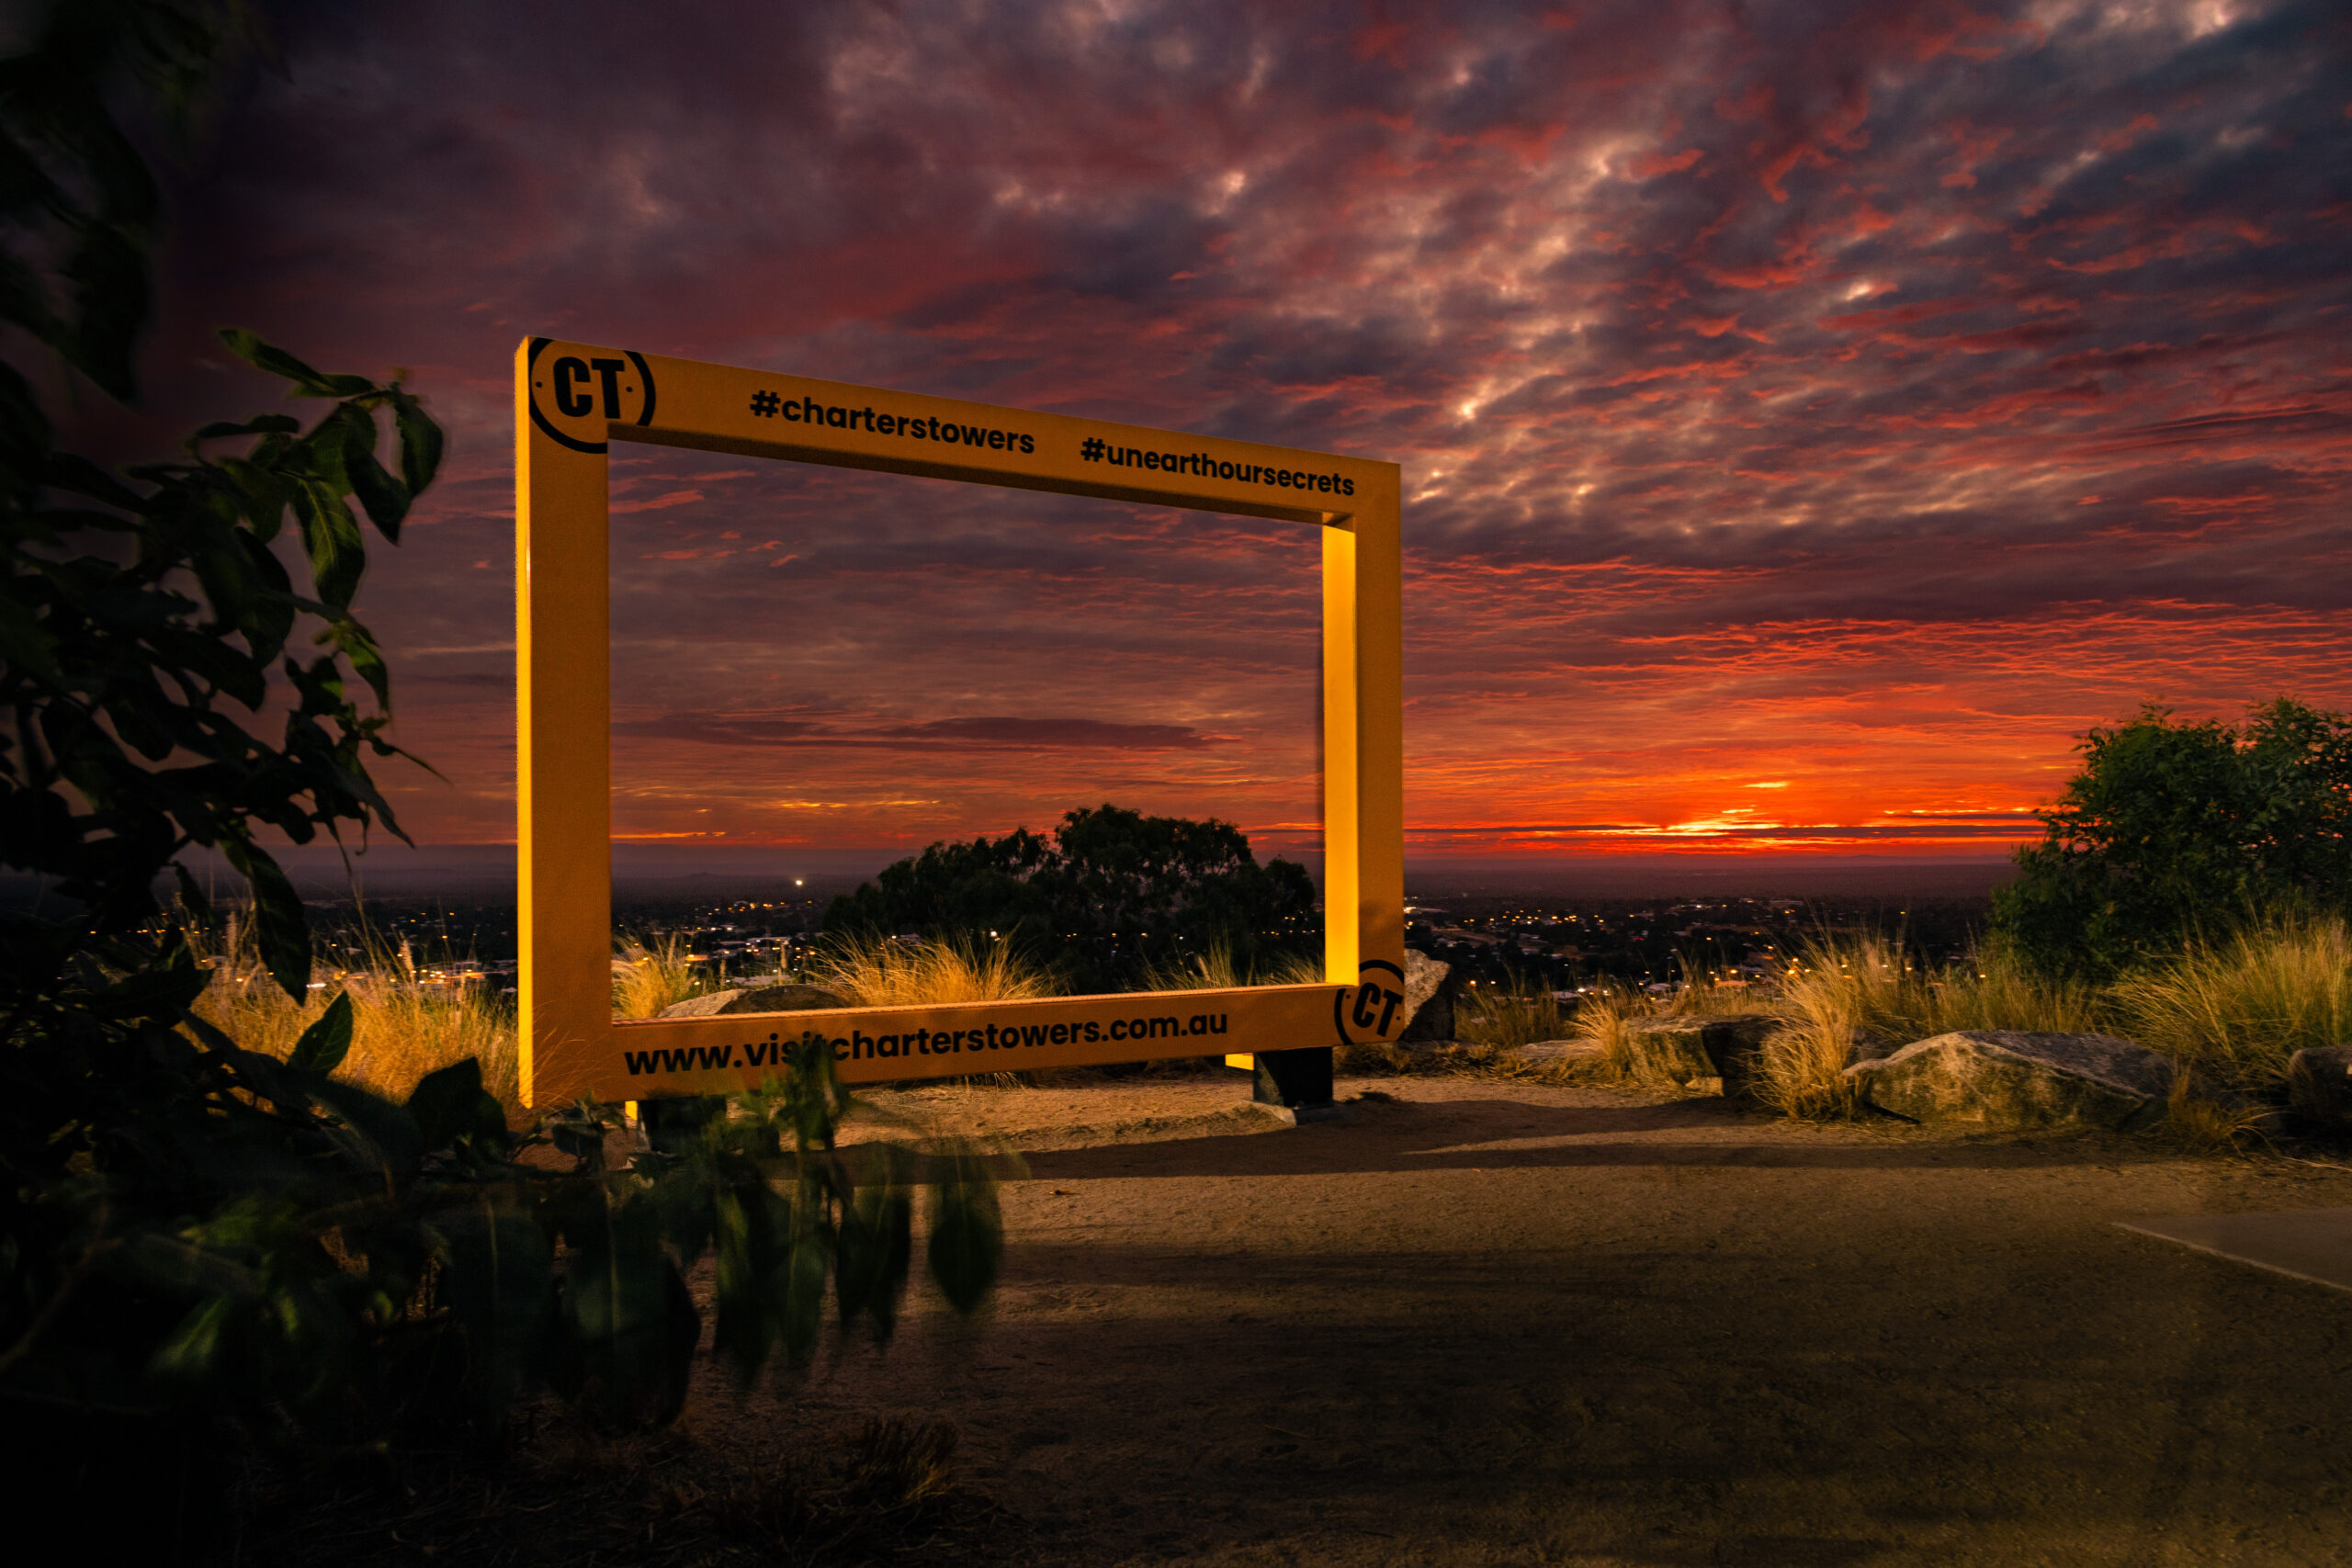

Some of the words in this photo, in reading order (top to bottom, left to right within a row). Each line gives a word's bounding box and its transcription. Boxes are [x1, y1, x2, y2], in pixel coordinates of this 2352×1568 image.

[554, 356, 625, 418] CT
[750, 389, 1035, 454] #charterstowers
[1081, 437, 1354, 496] #unearthoursecrets
[1353, 982, 1403, 1037] CT
